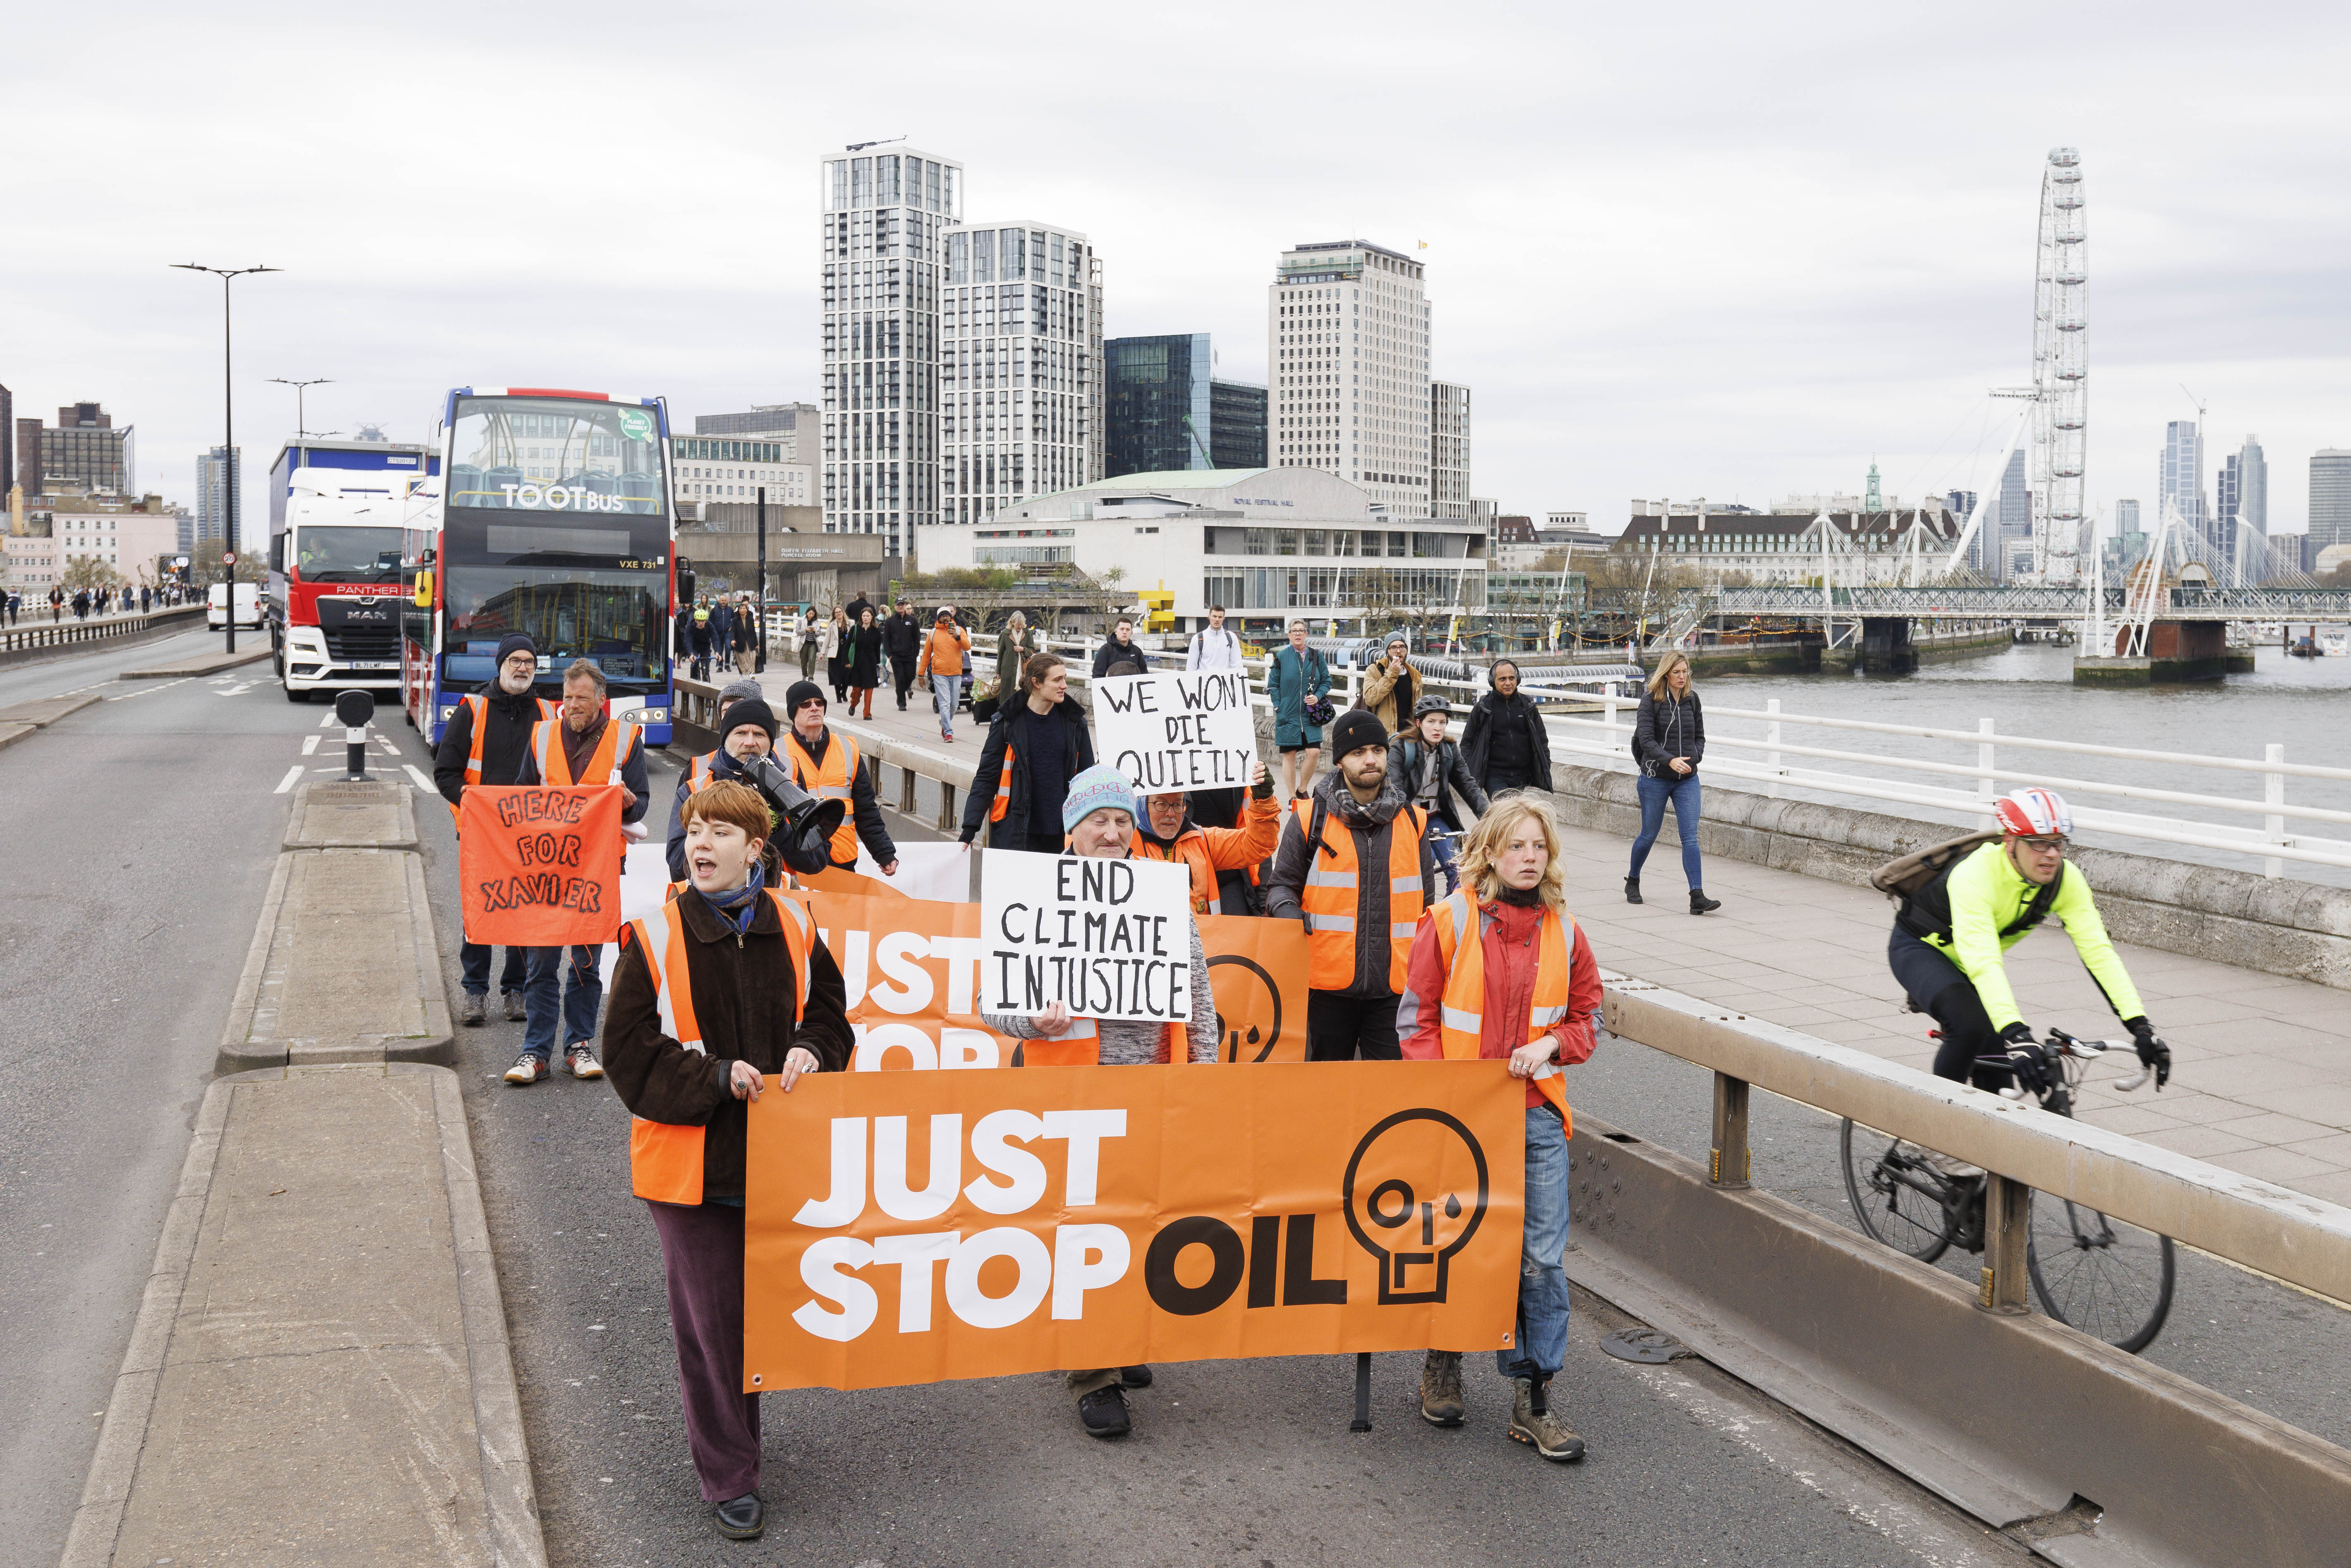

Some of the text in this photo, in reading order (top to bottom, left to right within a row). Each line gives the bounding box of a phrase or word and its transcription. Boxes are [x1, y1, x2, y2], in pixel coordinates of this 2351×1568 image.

[619, 560, 638, 568] VXE
[347, 611, 387, 620] MAN
[1100, 672, 1248, 713] WE WON'T
[1165, 714, 1212, 745] DIE
[1116, 749, 1250, 789] QUIETLY
[498, 790, 587, 827] HERE
[517, 833, 580, 867] FOR
[480, 873, 601, 913] XAVIER
[1057, 859, 1134, 905] END
[1002, 903, 1168, 957] CLIMATE
[817, 928, 981, 1015] UST
[993, 950, 1188, 1018] INJUSTICE
[791, 1109, 1128, 1228] JUST
[791, 1214, 1348, 1342] STOP OIL
